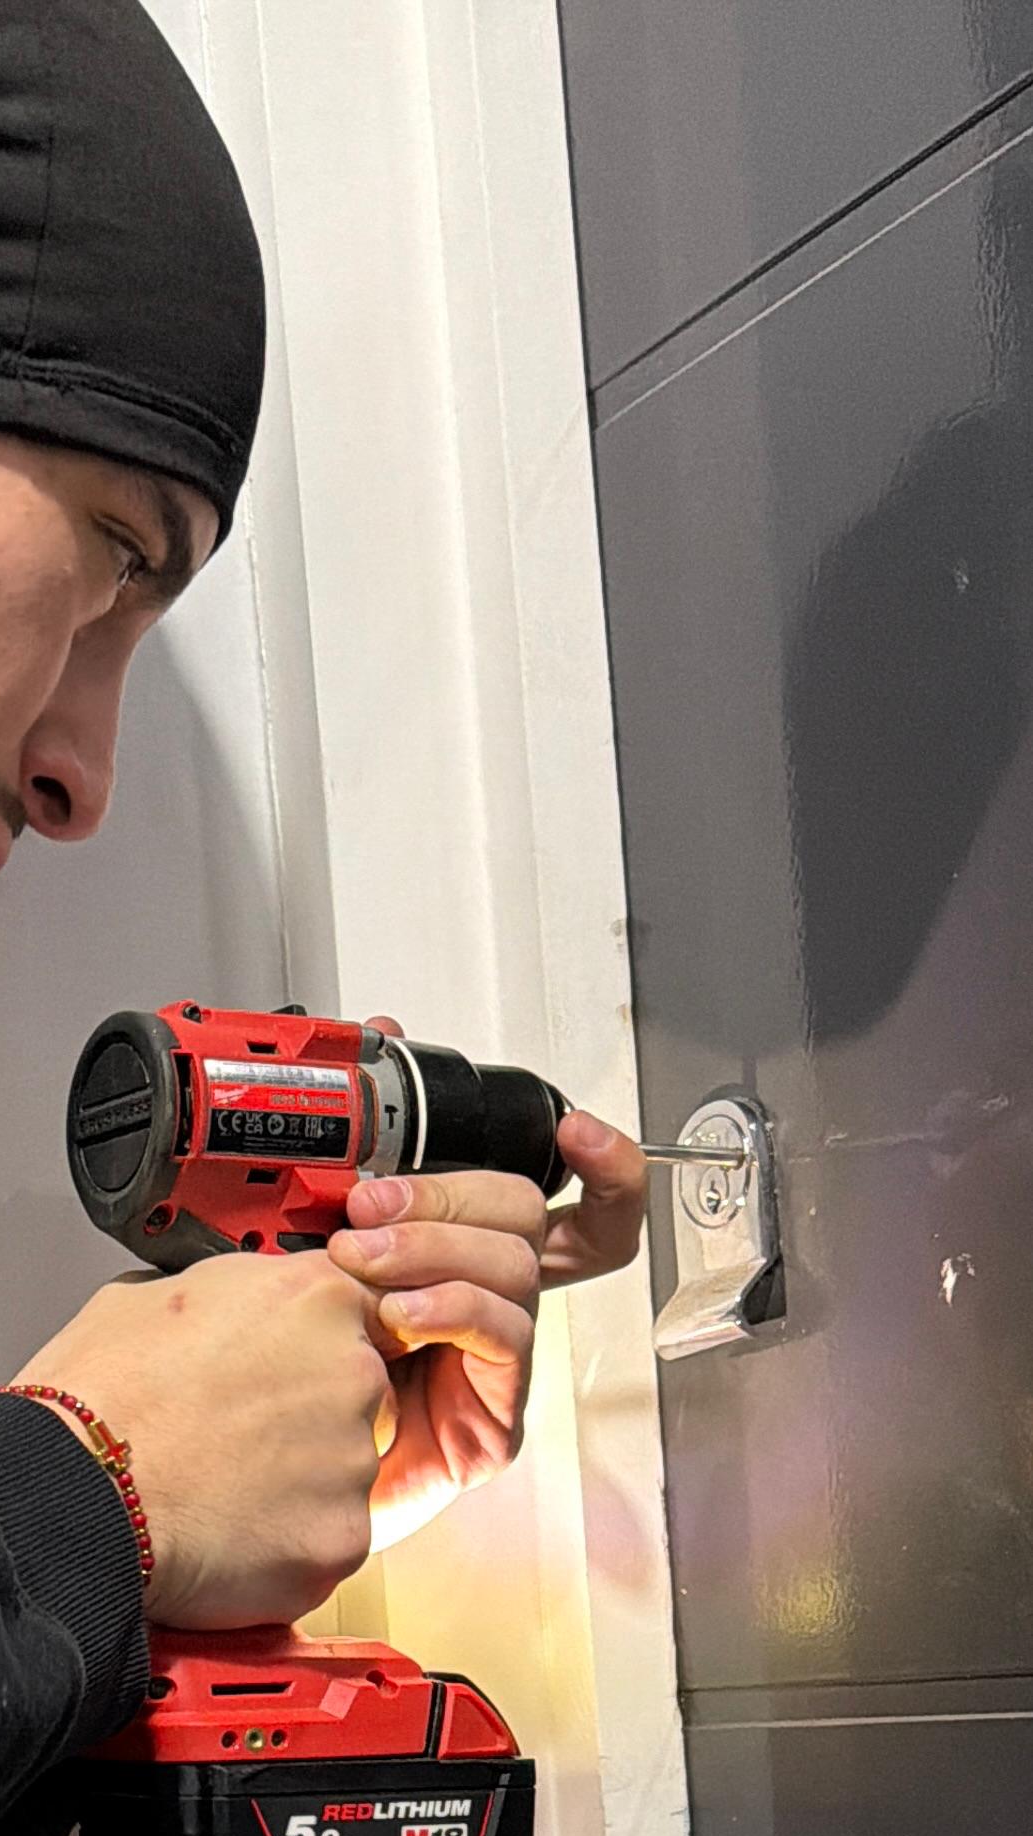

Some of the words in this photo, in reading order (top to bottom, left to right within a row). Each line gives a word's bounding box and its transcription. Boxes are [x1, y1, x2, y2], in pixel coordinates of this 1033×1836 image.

[217, 1111, 243, 1133] CE
[245, 1112, 264, 1123] UK
[244, 1123, 264, 1135] CA
[322, 1799, 472, 1821] REDLITHIUM
